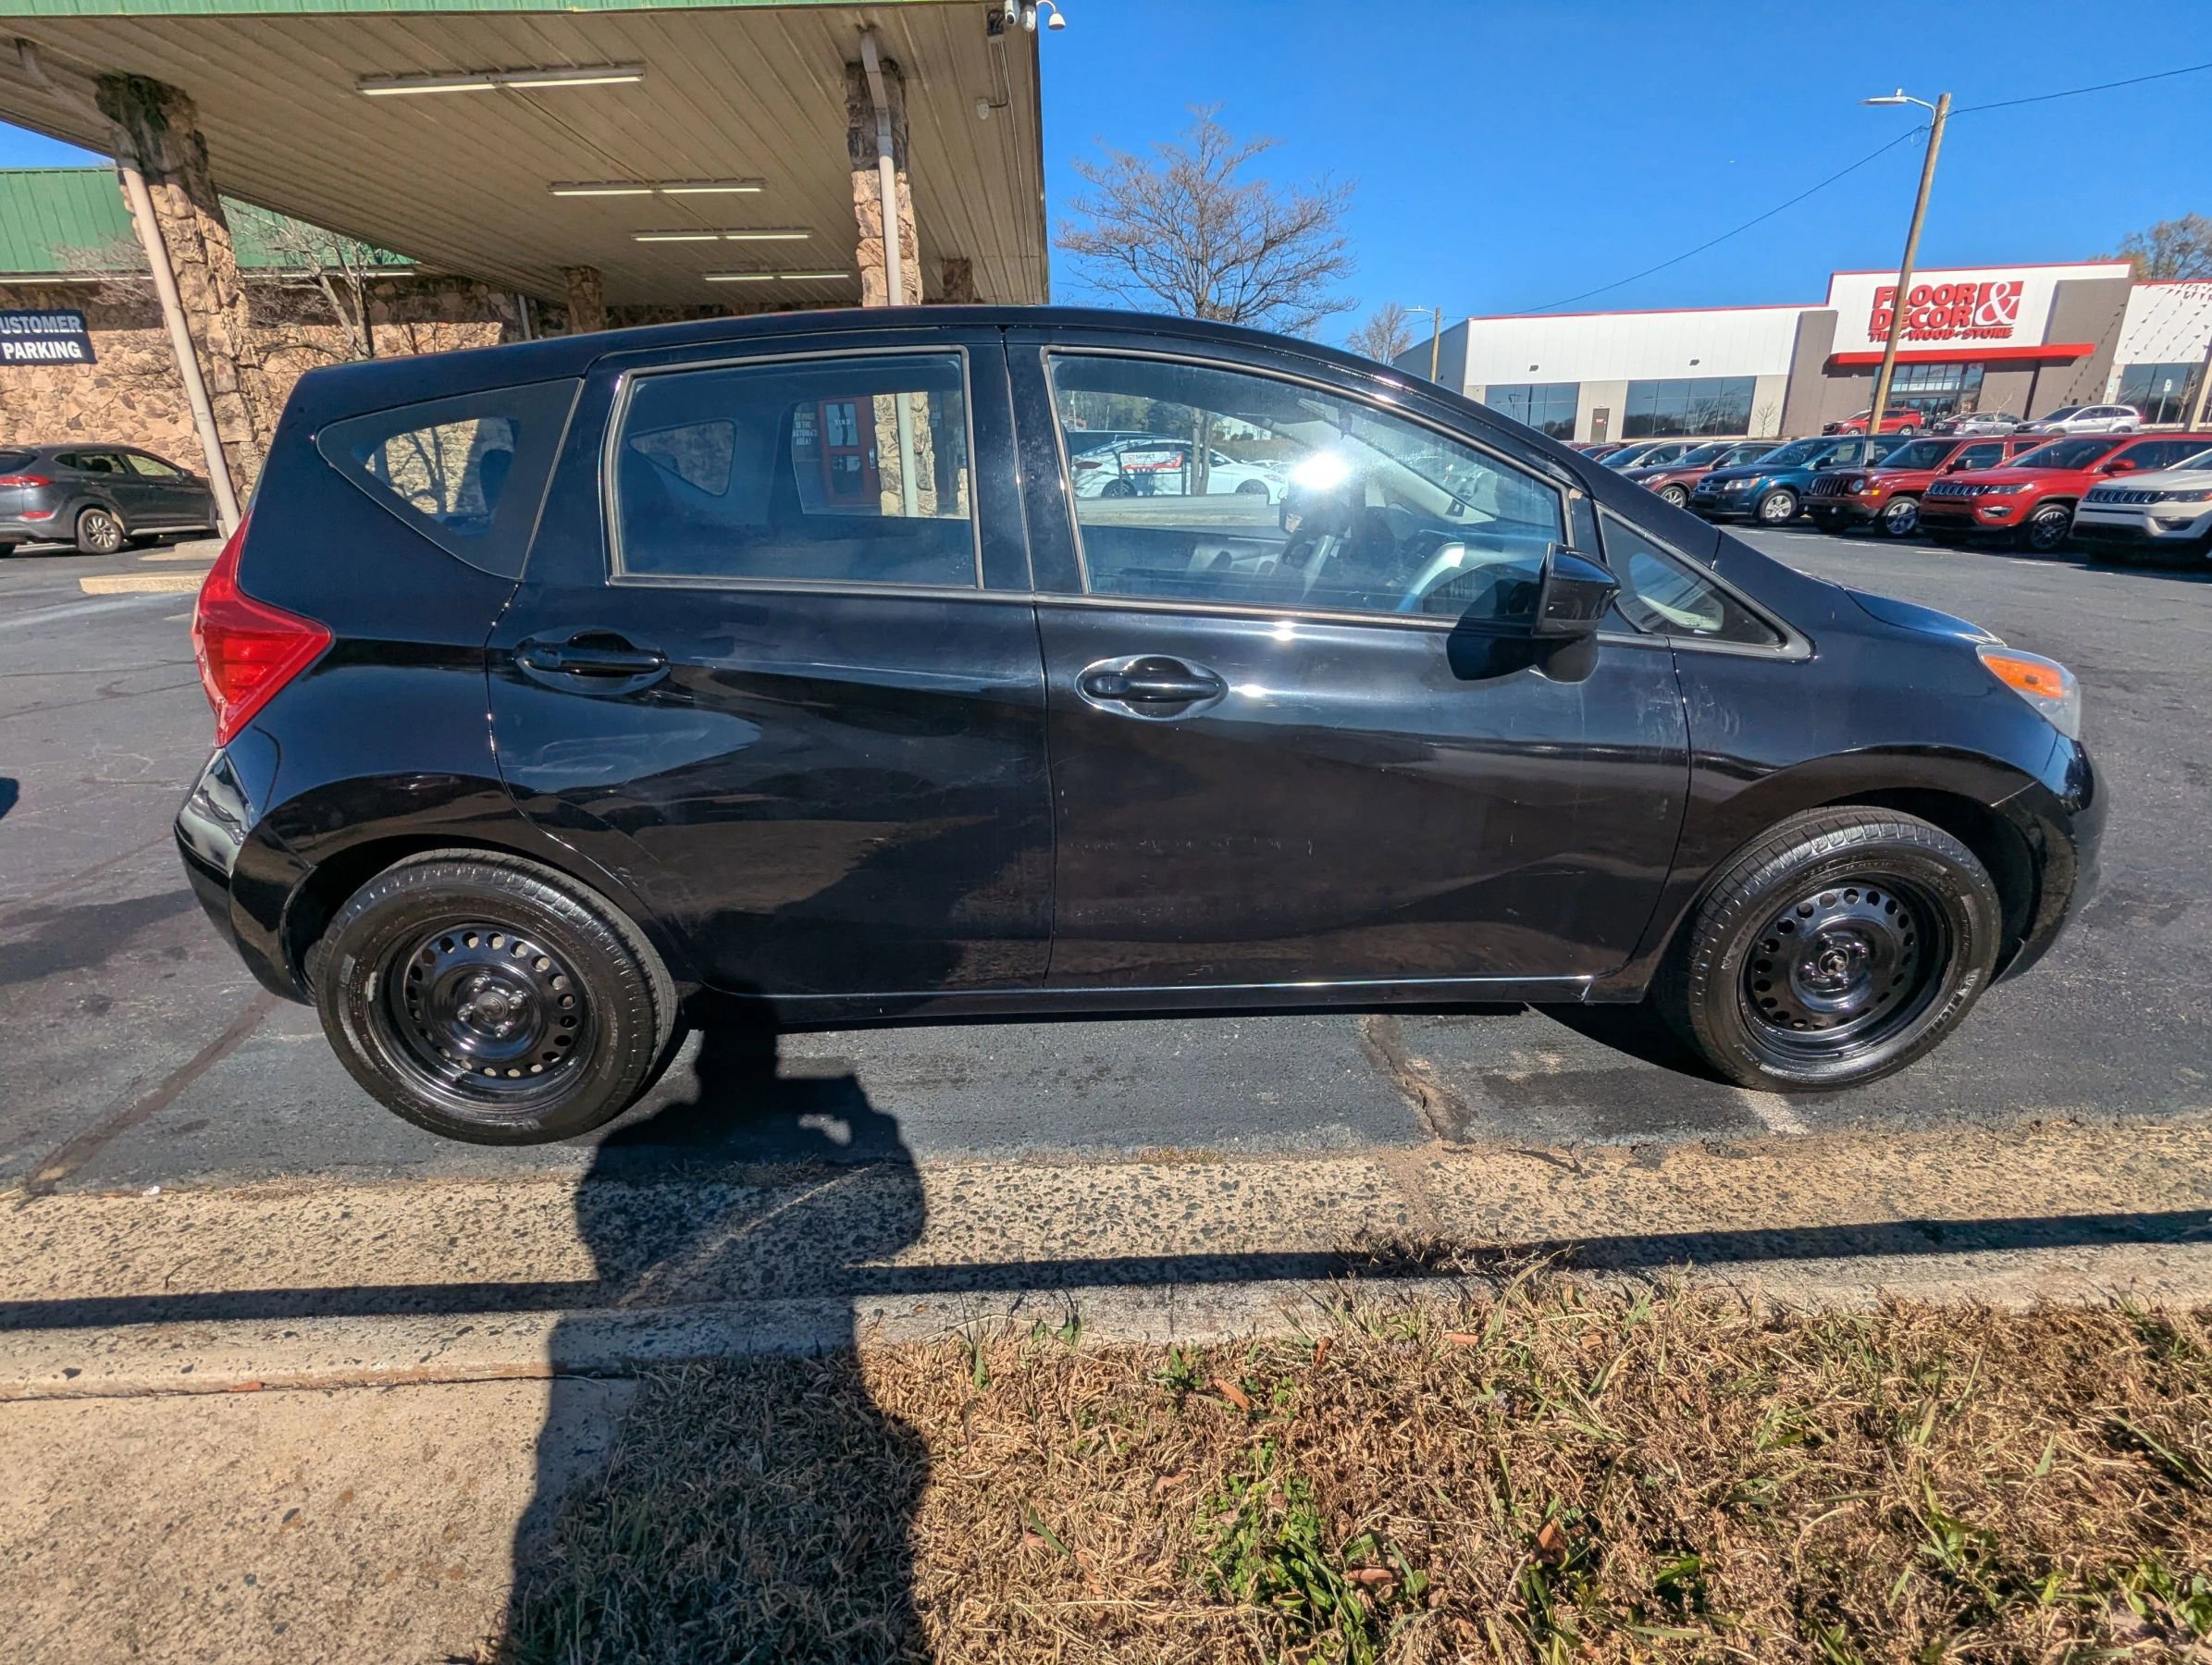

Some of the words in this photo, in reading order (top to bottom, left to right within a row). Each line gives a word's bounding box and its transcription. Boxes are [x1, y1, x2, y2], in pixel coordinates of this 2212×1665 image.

[1974, 281, 2021, 326] &
[0, 315, 83, 334] USTOMER
[2, 341, 82, 360] PARKING
